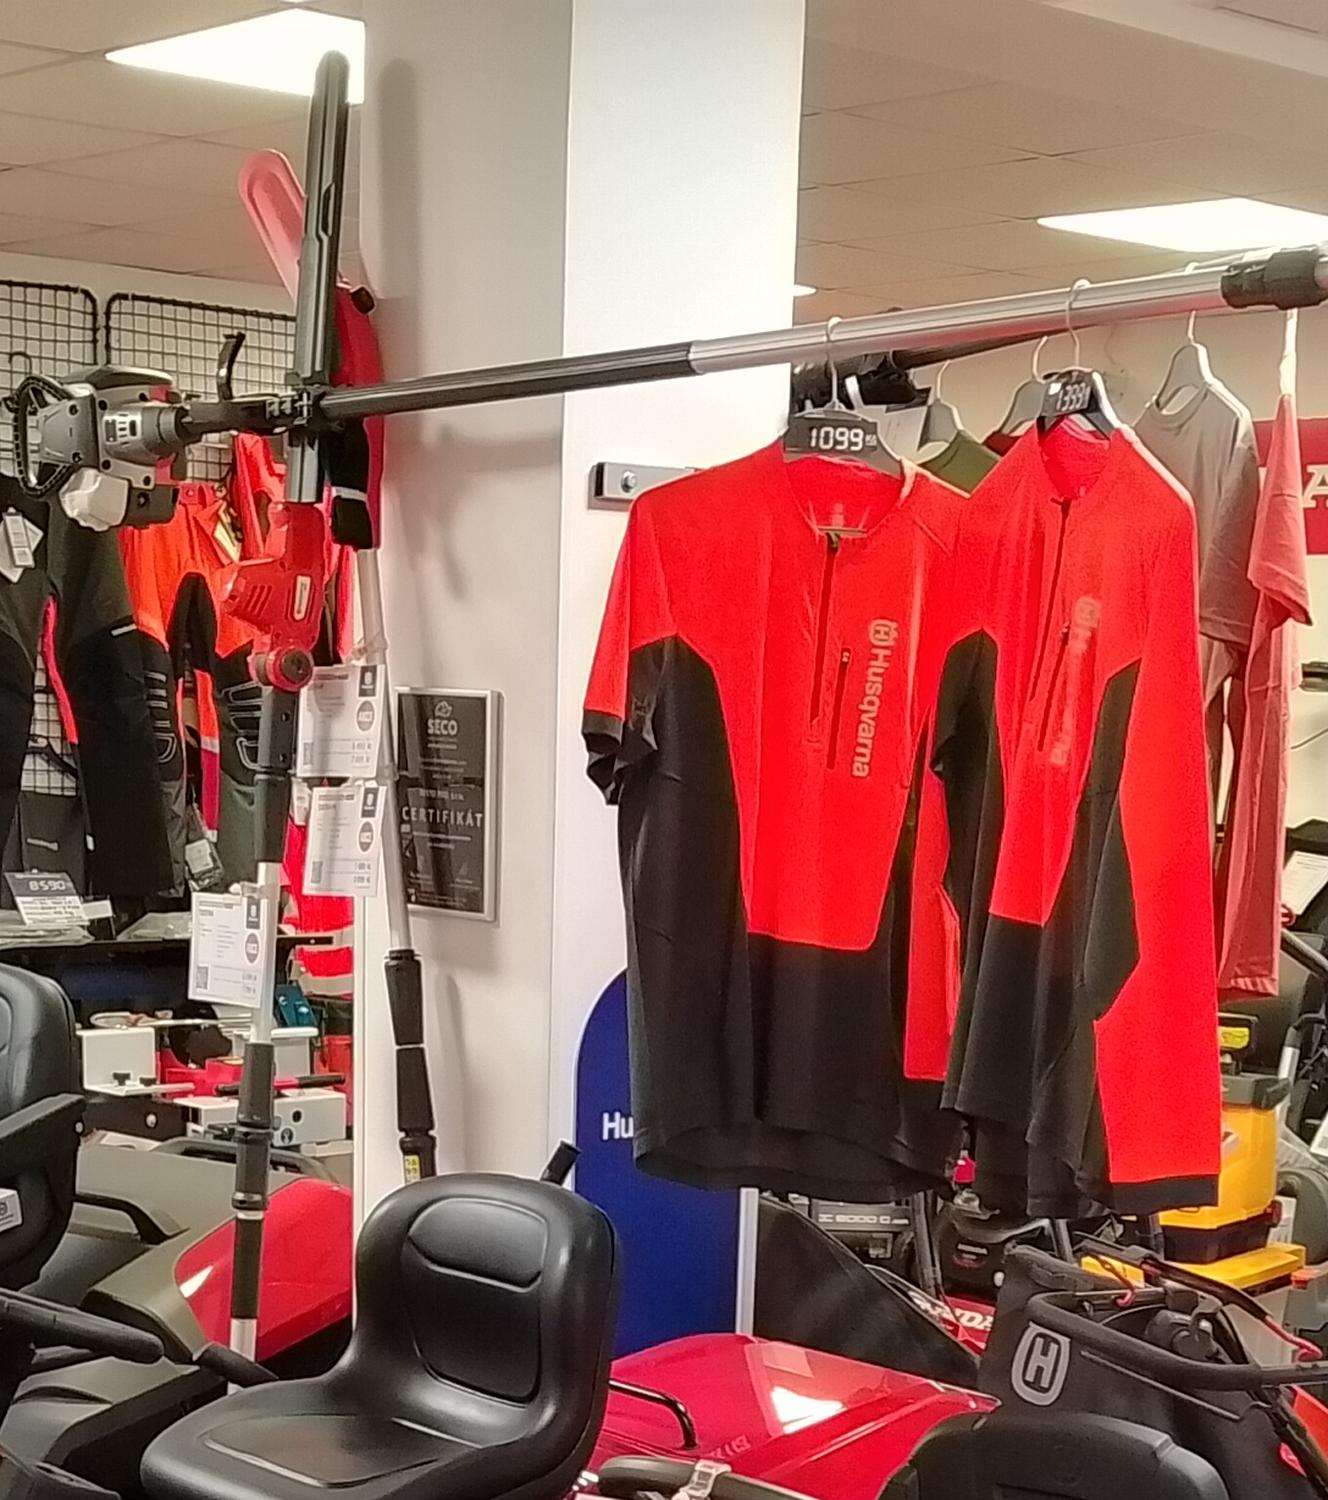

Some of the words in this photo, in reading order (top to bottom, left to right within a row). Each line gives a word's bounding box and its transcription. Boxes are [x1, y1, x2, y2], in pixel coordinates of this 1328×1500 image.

[808, 427, 865, 450] 1099
[852, 648, 892, 778] Husqvarna
[427, 719, 458, 736] SECO
[401, 804, 483, 828] CERTIFIKÁT
